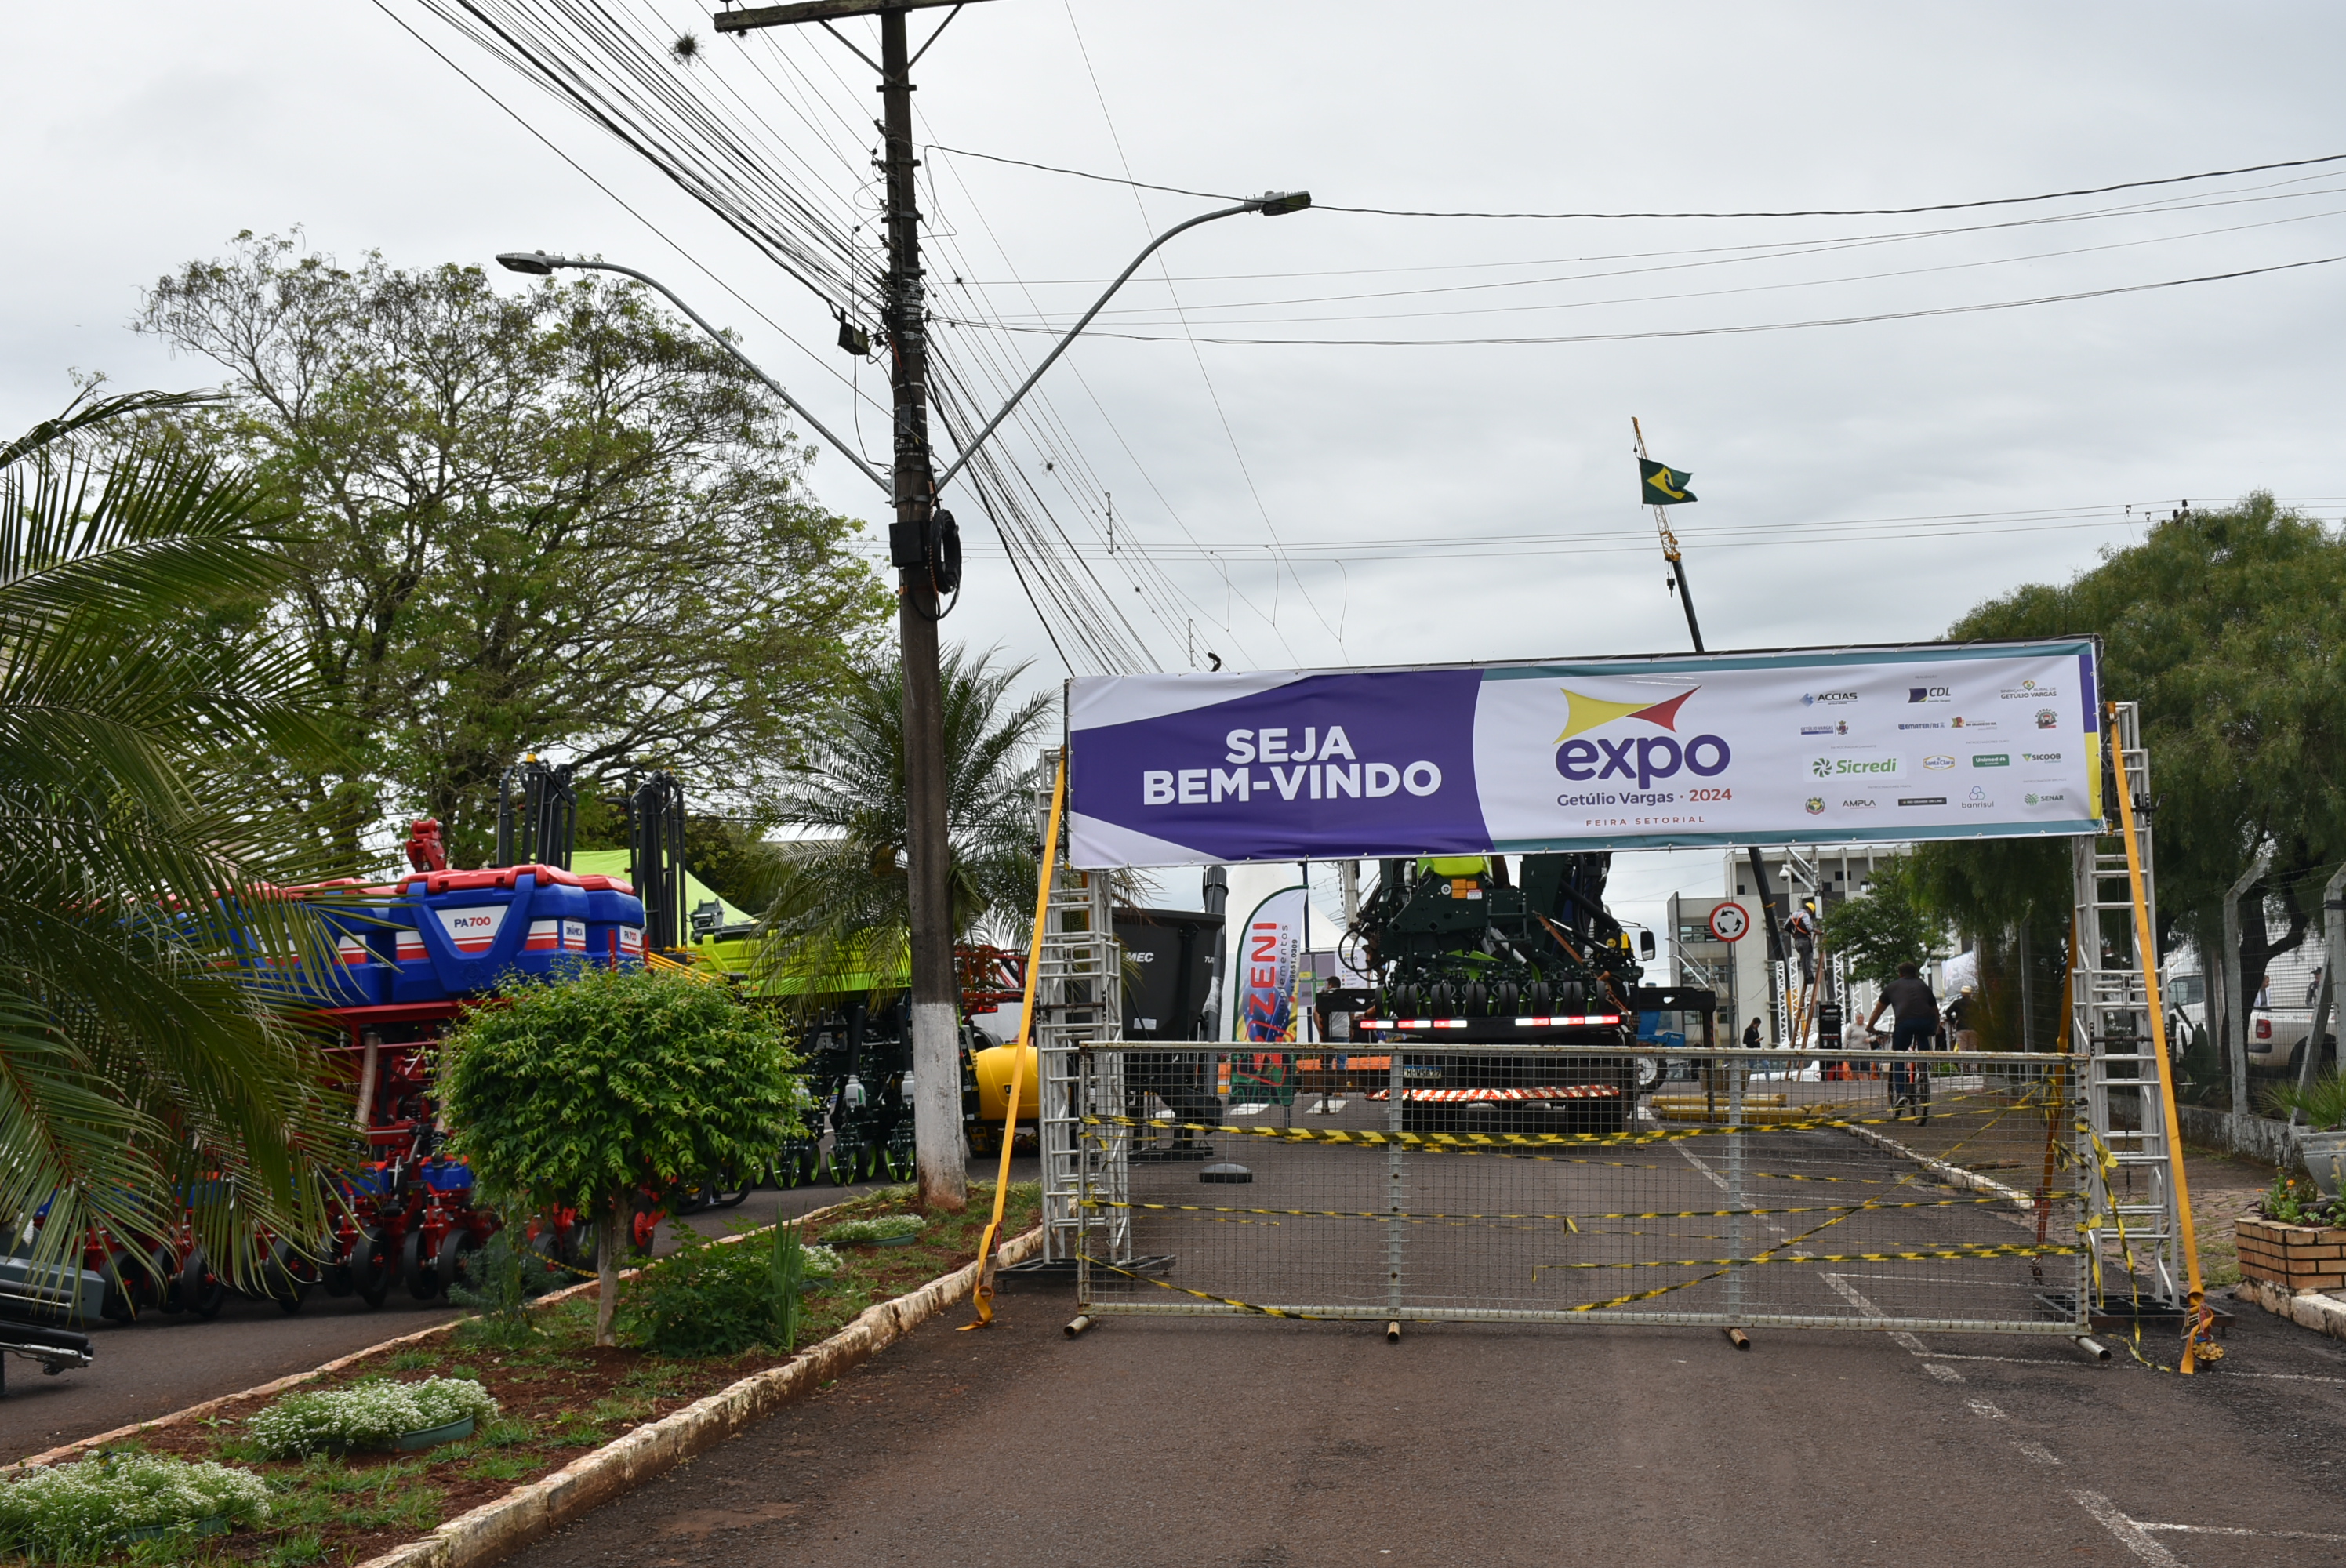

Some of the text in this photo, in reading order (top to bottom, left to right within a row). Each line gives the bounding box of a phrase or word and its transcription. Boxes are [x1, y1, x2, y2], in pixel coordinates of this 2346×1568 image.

[1817, 692, 1858, 702] ACCIAS
[1929, 687, 1952, 697] CDL
[1225, 725, 1356, 764] SEJA
[1555, 734, 1731, 790] expo
[2032, 753, 2061, 761] SICOOB
[1836, 758, 1897, 775] Sicredi
[1143, 760, 1442, 806] BEM-VINDO
[1556, 788, 1732, 807] Getúlio Vargas 2024
[1961, 800, 1995, 809] banrisul
[1635, 816, 1705, 825] SETORIAL
[1248, 923, 1277, 1016] ZENI
